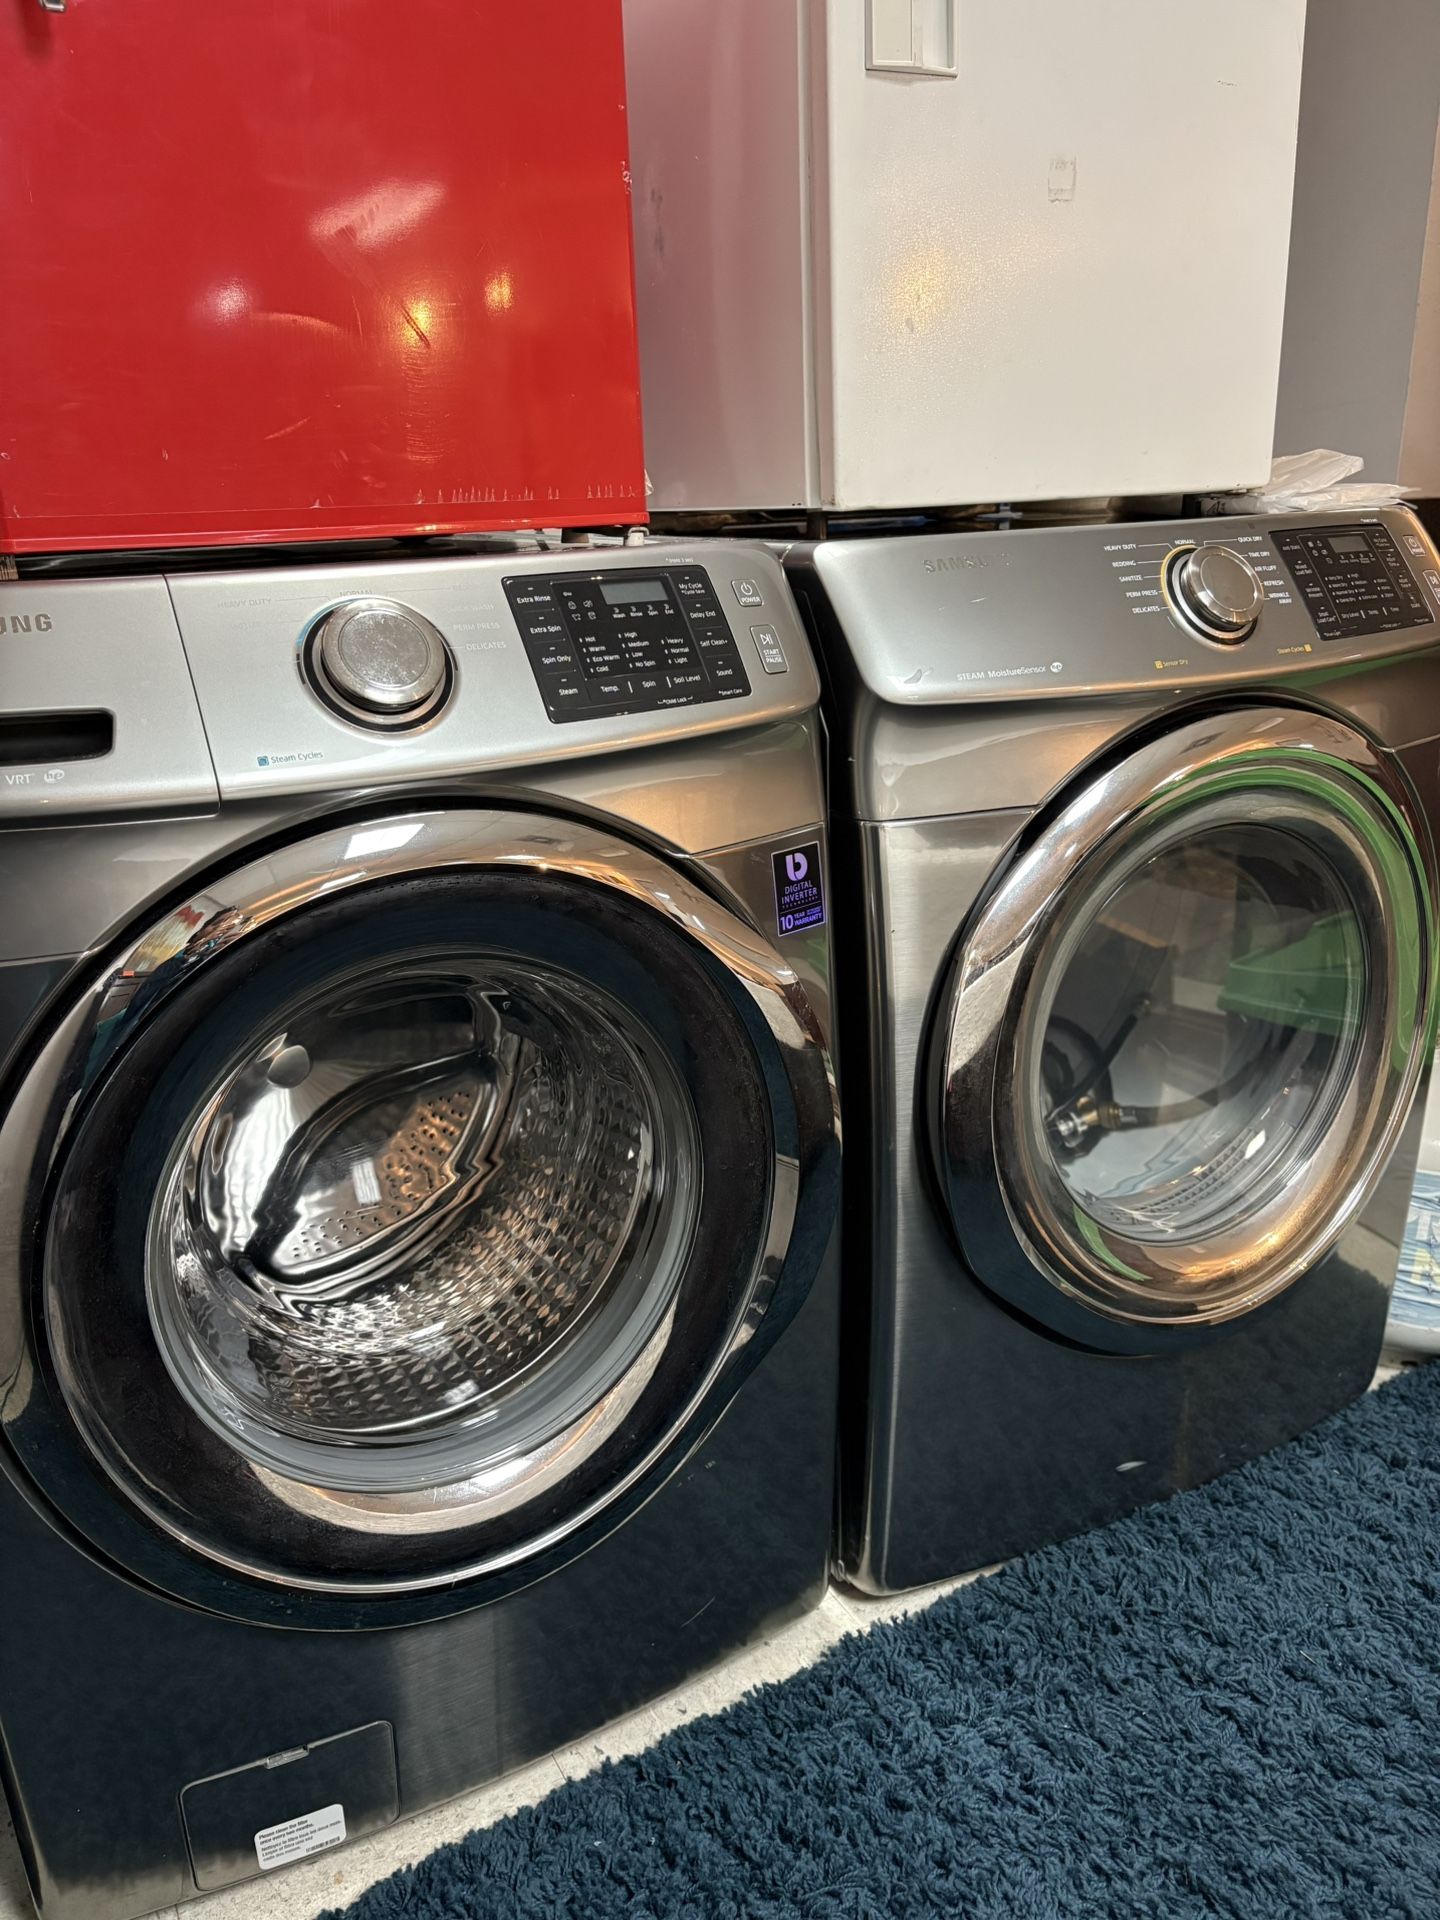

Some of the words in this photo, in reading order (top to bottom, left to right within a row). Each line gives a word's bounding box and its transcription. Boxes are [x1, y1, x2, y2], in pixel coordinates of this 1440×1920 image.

[678, 583, 688, 591] My
[516, 596, 534, 604] Extra
[533, 594, 552, 603] Rinse
[705, 610, 716, 618] End
[529, 626, 548, 635] Extra
[547, 625, 562, 633] Spin
[623, 631, 638, 639] High
[465, 641, 507, 651] DELICATES
[627, 640, 650, 648] Medium
[699, 640, 711, 648] Self
[588, 645, 606, 653] Warm
[670, 646, 690, 654] Normal
[763, 648, 780, 656] START
[541, 656, 557, 665] Spin
[556, 654, 572, 664] Only
[603, 654, 621, 662] Warm
[673, 656, 688, 664] Light
[643, 660, 657, 668] Spin
[596, 665, 610, 673] Cold
[716, 668, 733, 677] Sound
[673, 676, 686, 684] Soil
[685, 674, 701, 682] Level
[956, 671, 985, 682] STEAM
[600, 684, 620, 694] Temp.
[641, 680, 657, 689] Spin
[558, 687, 578, 696] Steam
[270, 754, 297, 764] Steam
[297, 751, 324, 762] Cycles
[785, 880, 813, 895] DIGITAL
[781, 887, 818, 905] INVERTER
[780, 914, 794, 931] 10
